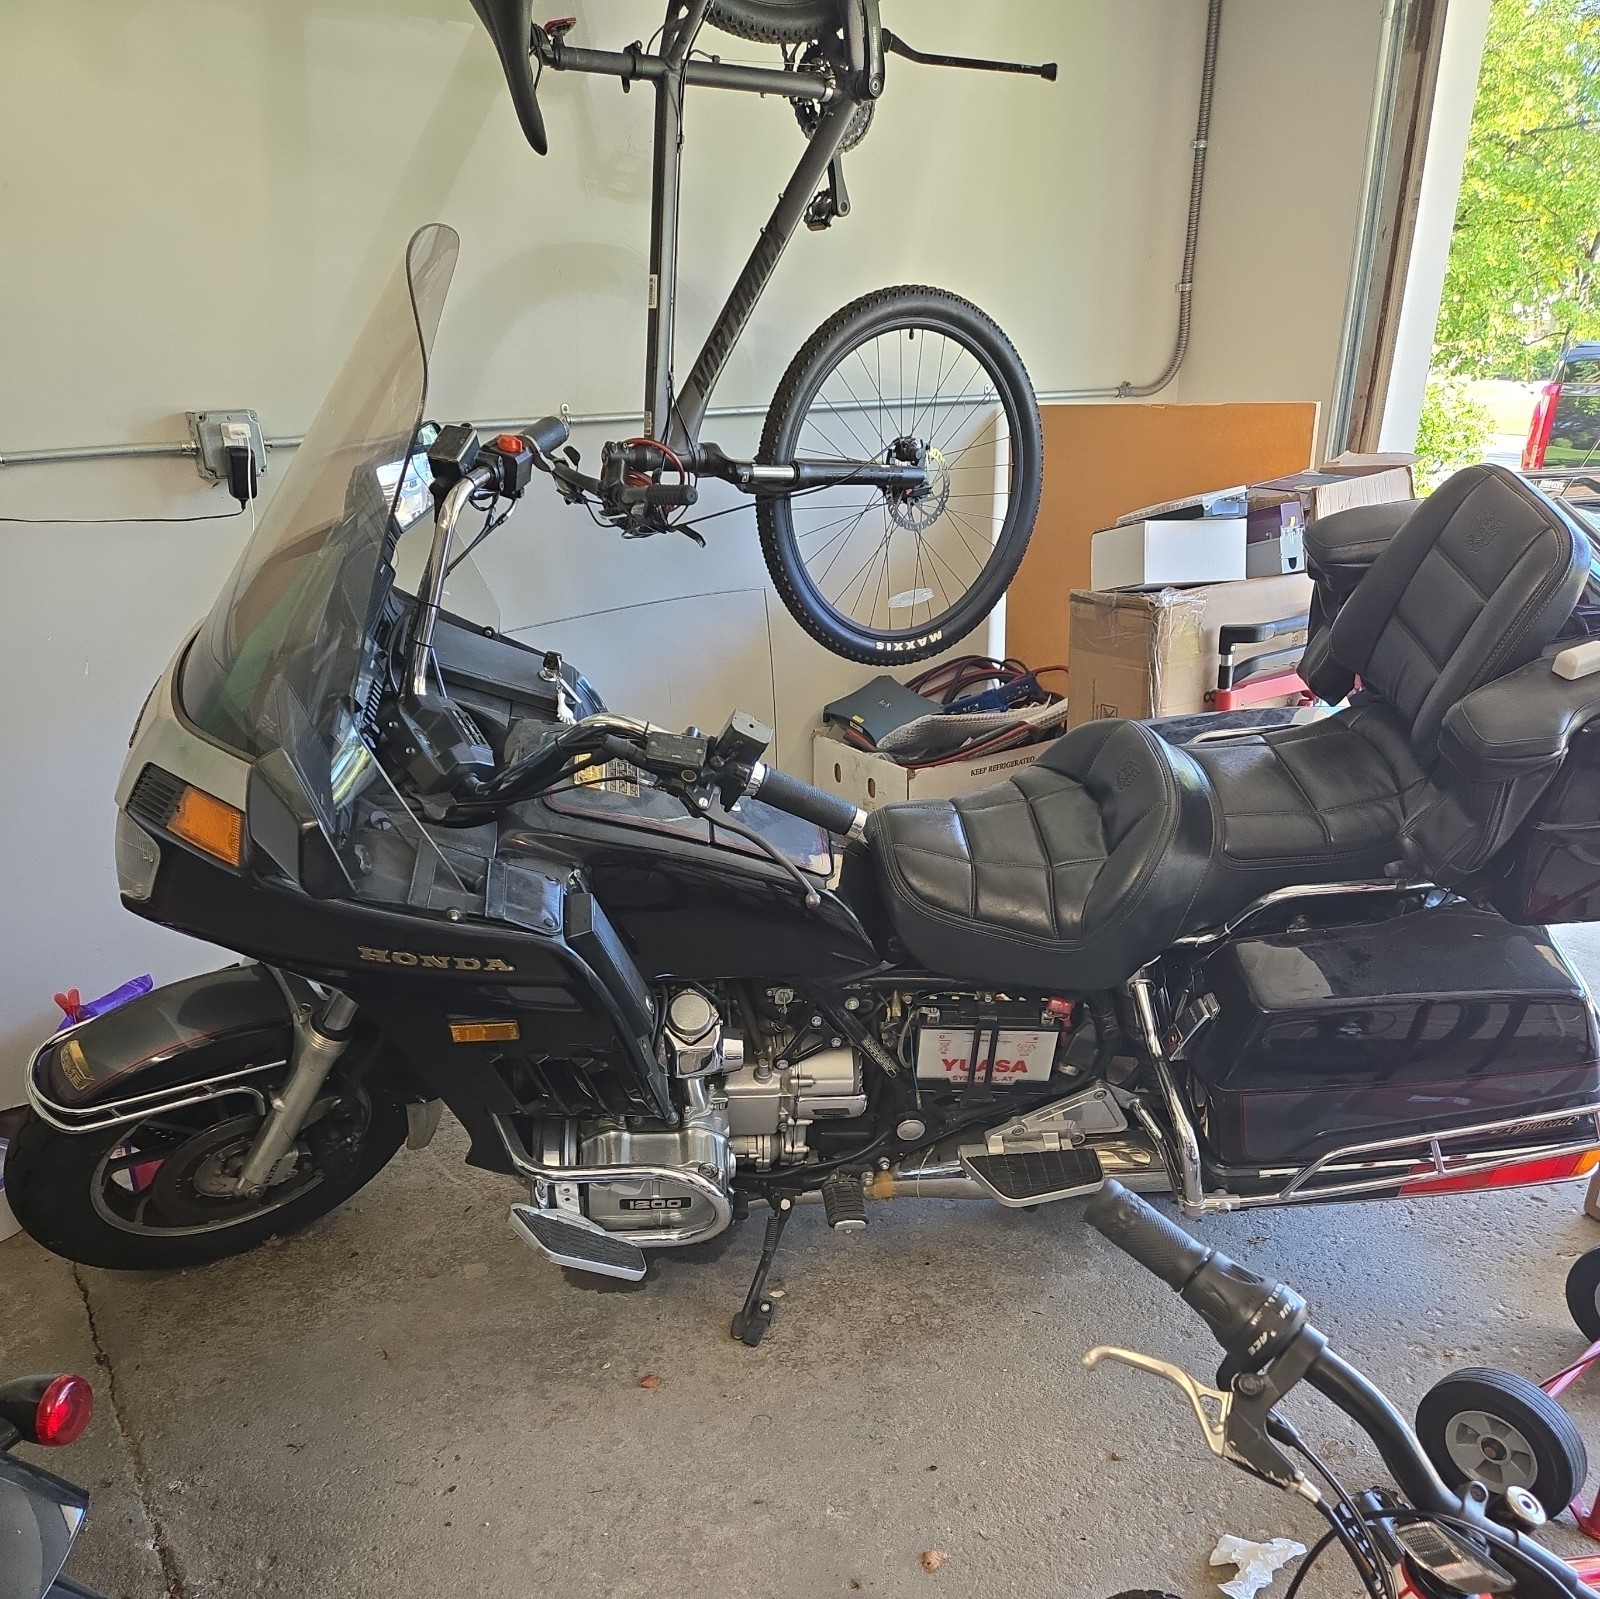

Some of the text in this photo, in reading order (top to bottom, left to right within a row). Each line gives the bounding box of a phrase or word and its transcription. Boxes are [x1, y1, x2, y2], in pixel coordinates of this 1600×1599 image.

[692, 214, 786, 400] NORTHROCK
[875, 630, 943, 652] MAXXIS
[970, 755, 1036, 777] KEEP REFRIGERATED
[356, 945, 516, 972] HONDA
[629, 1198, 682, 1210] 1200
